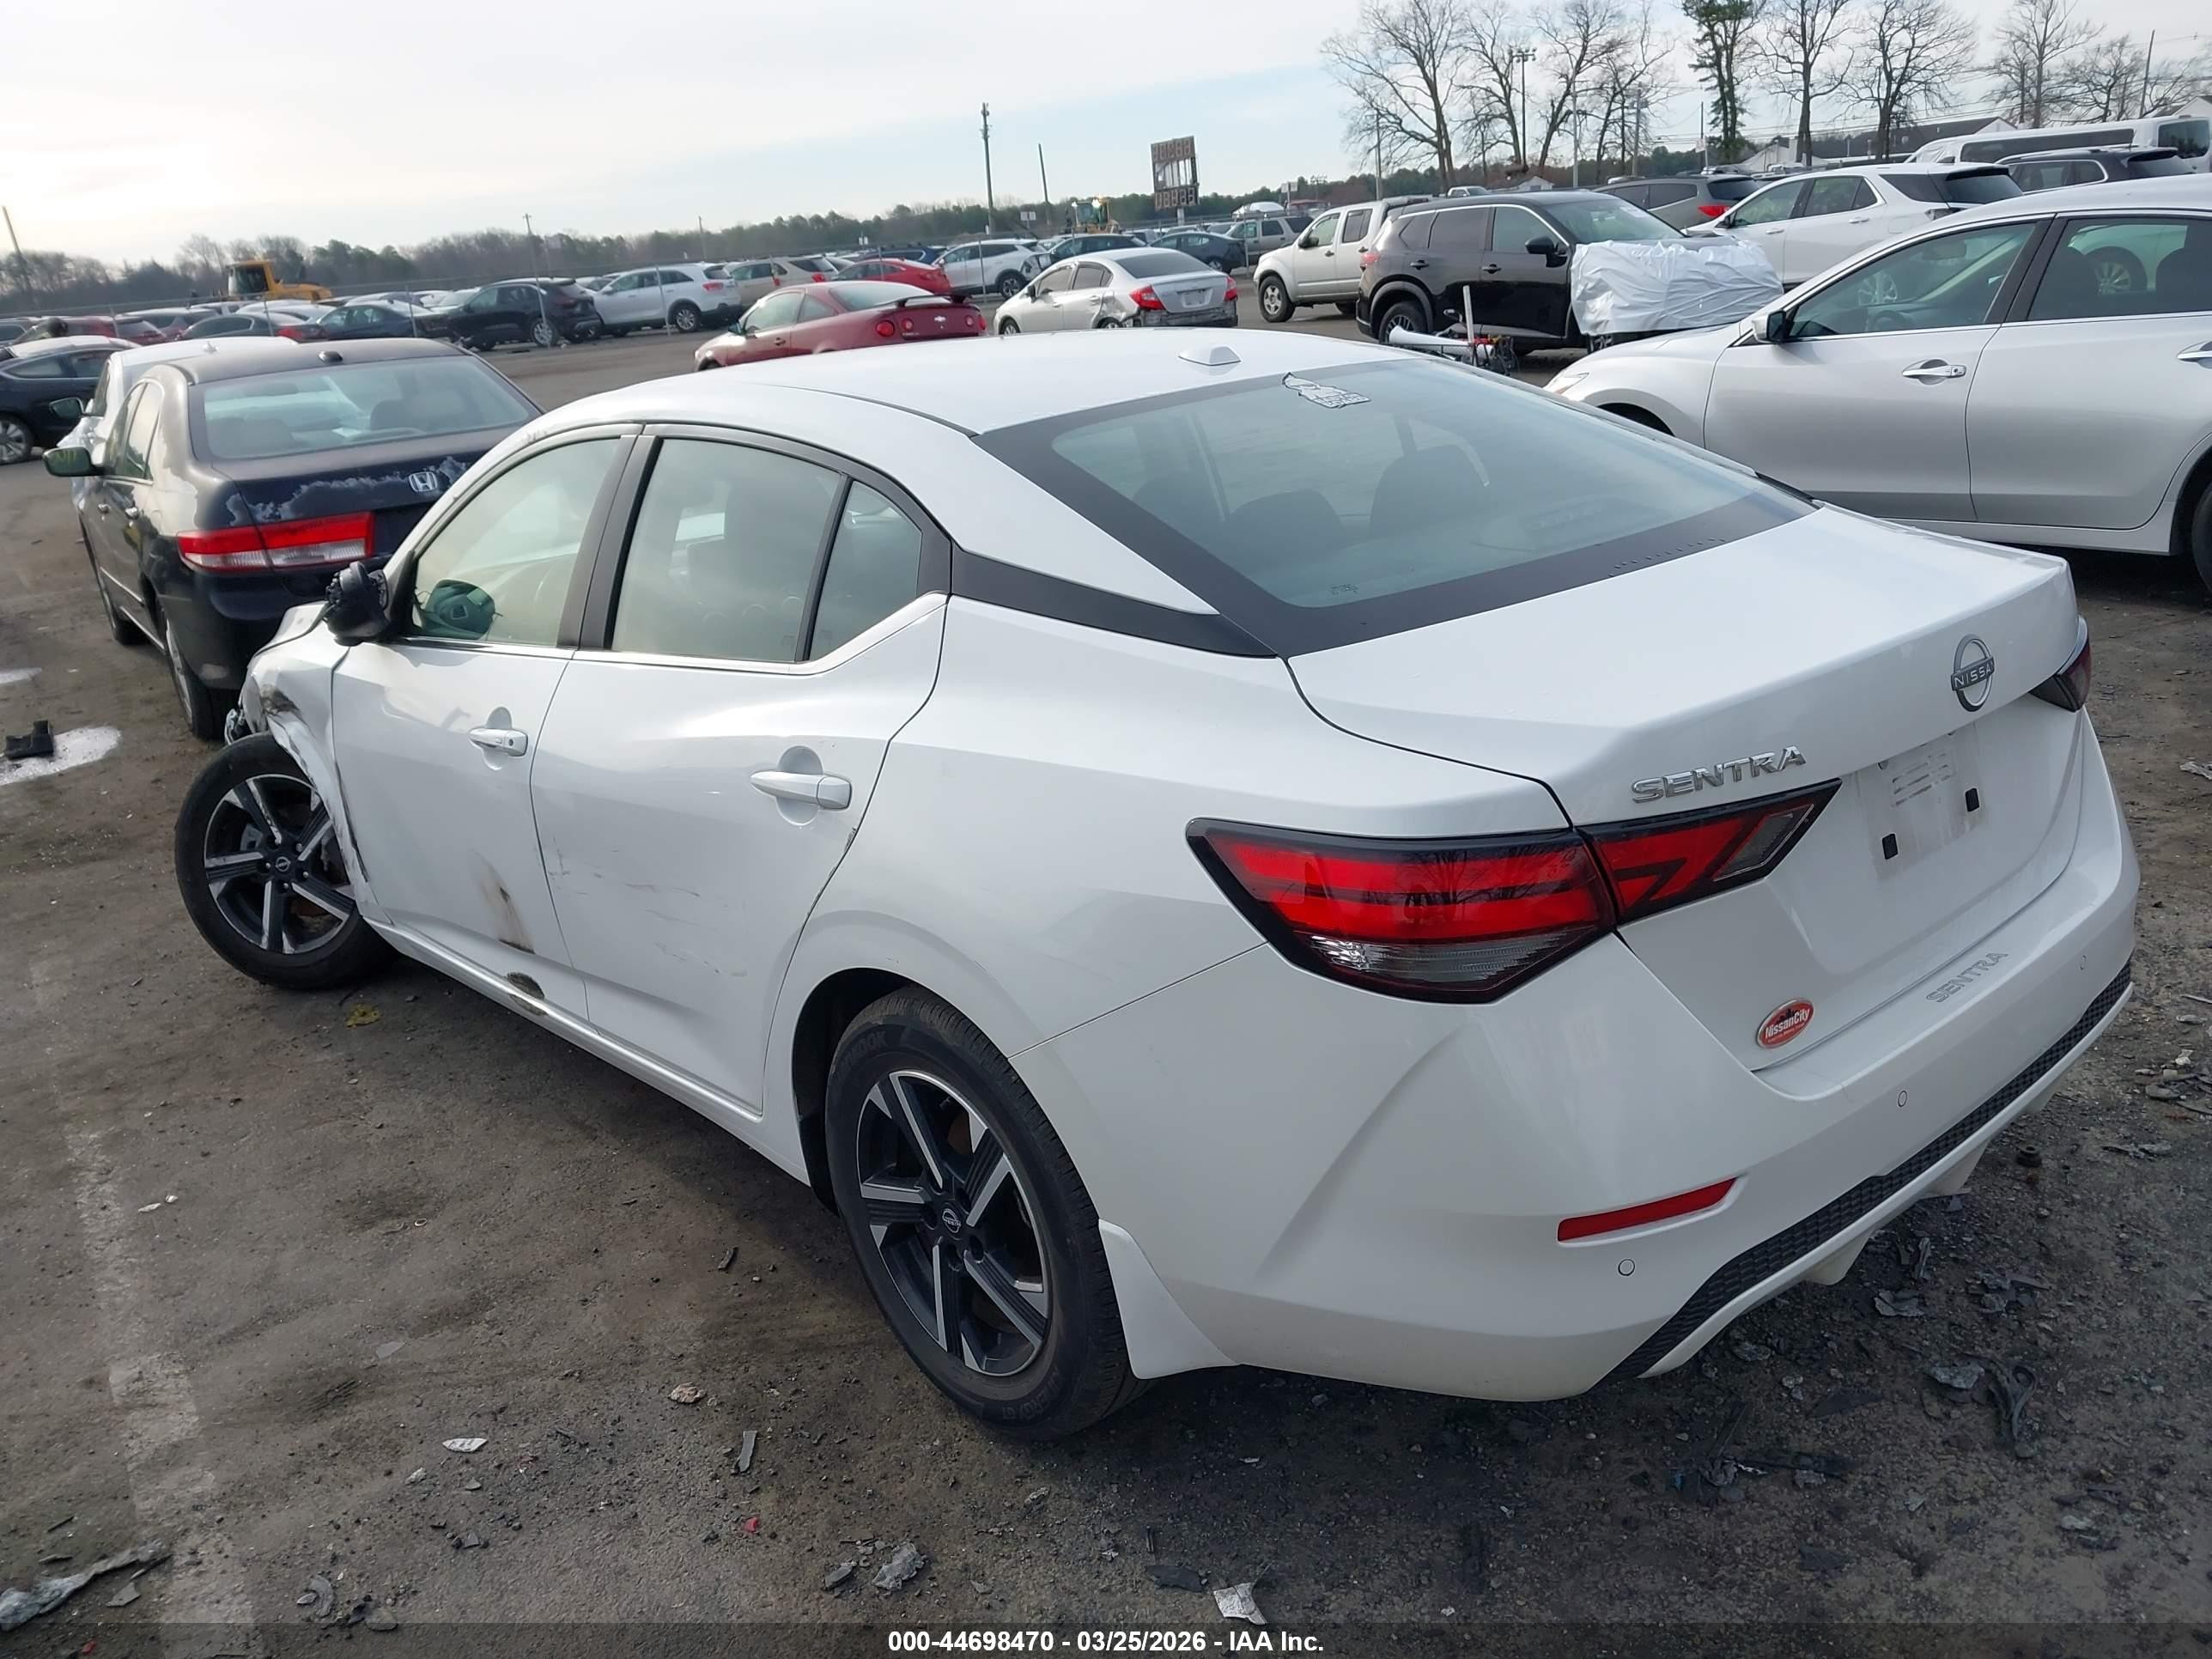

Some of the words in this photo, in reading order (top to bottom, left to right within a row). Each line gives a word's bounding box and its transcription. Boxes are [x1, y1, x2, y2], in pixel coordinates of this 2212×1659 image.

[1632, 744, 1807, 804] SENTRA
[1925, 952, 2008, 1003] SENTRA
[1765, 1008, 1810, 1040] NissanCity
